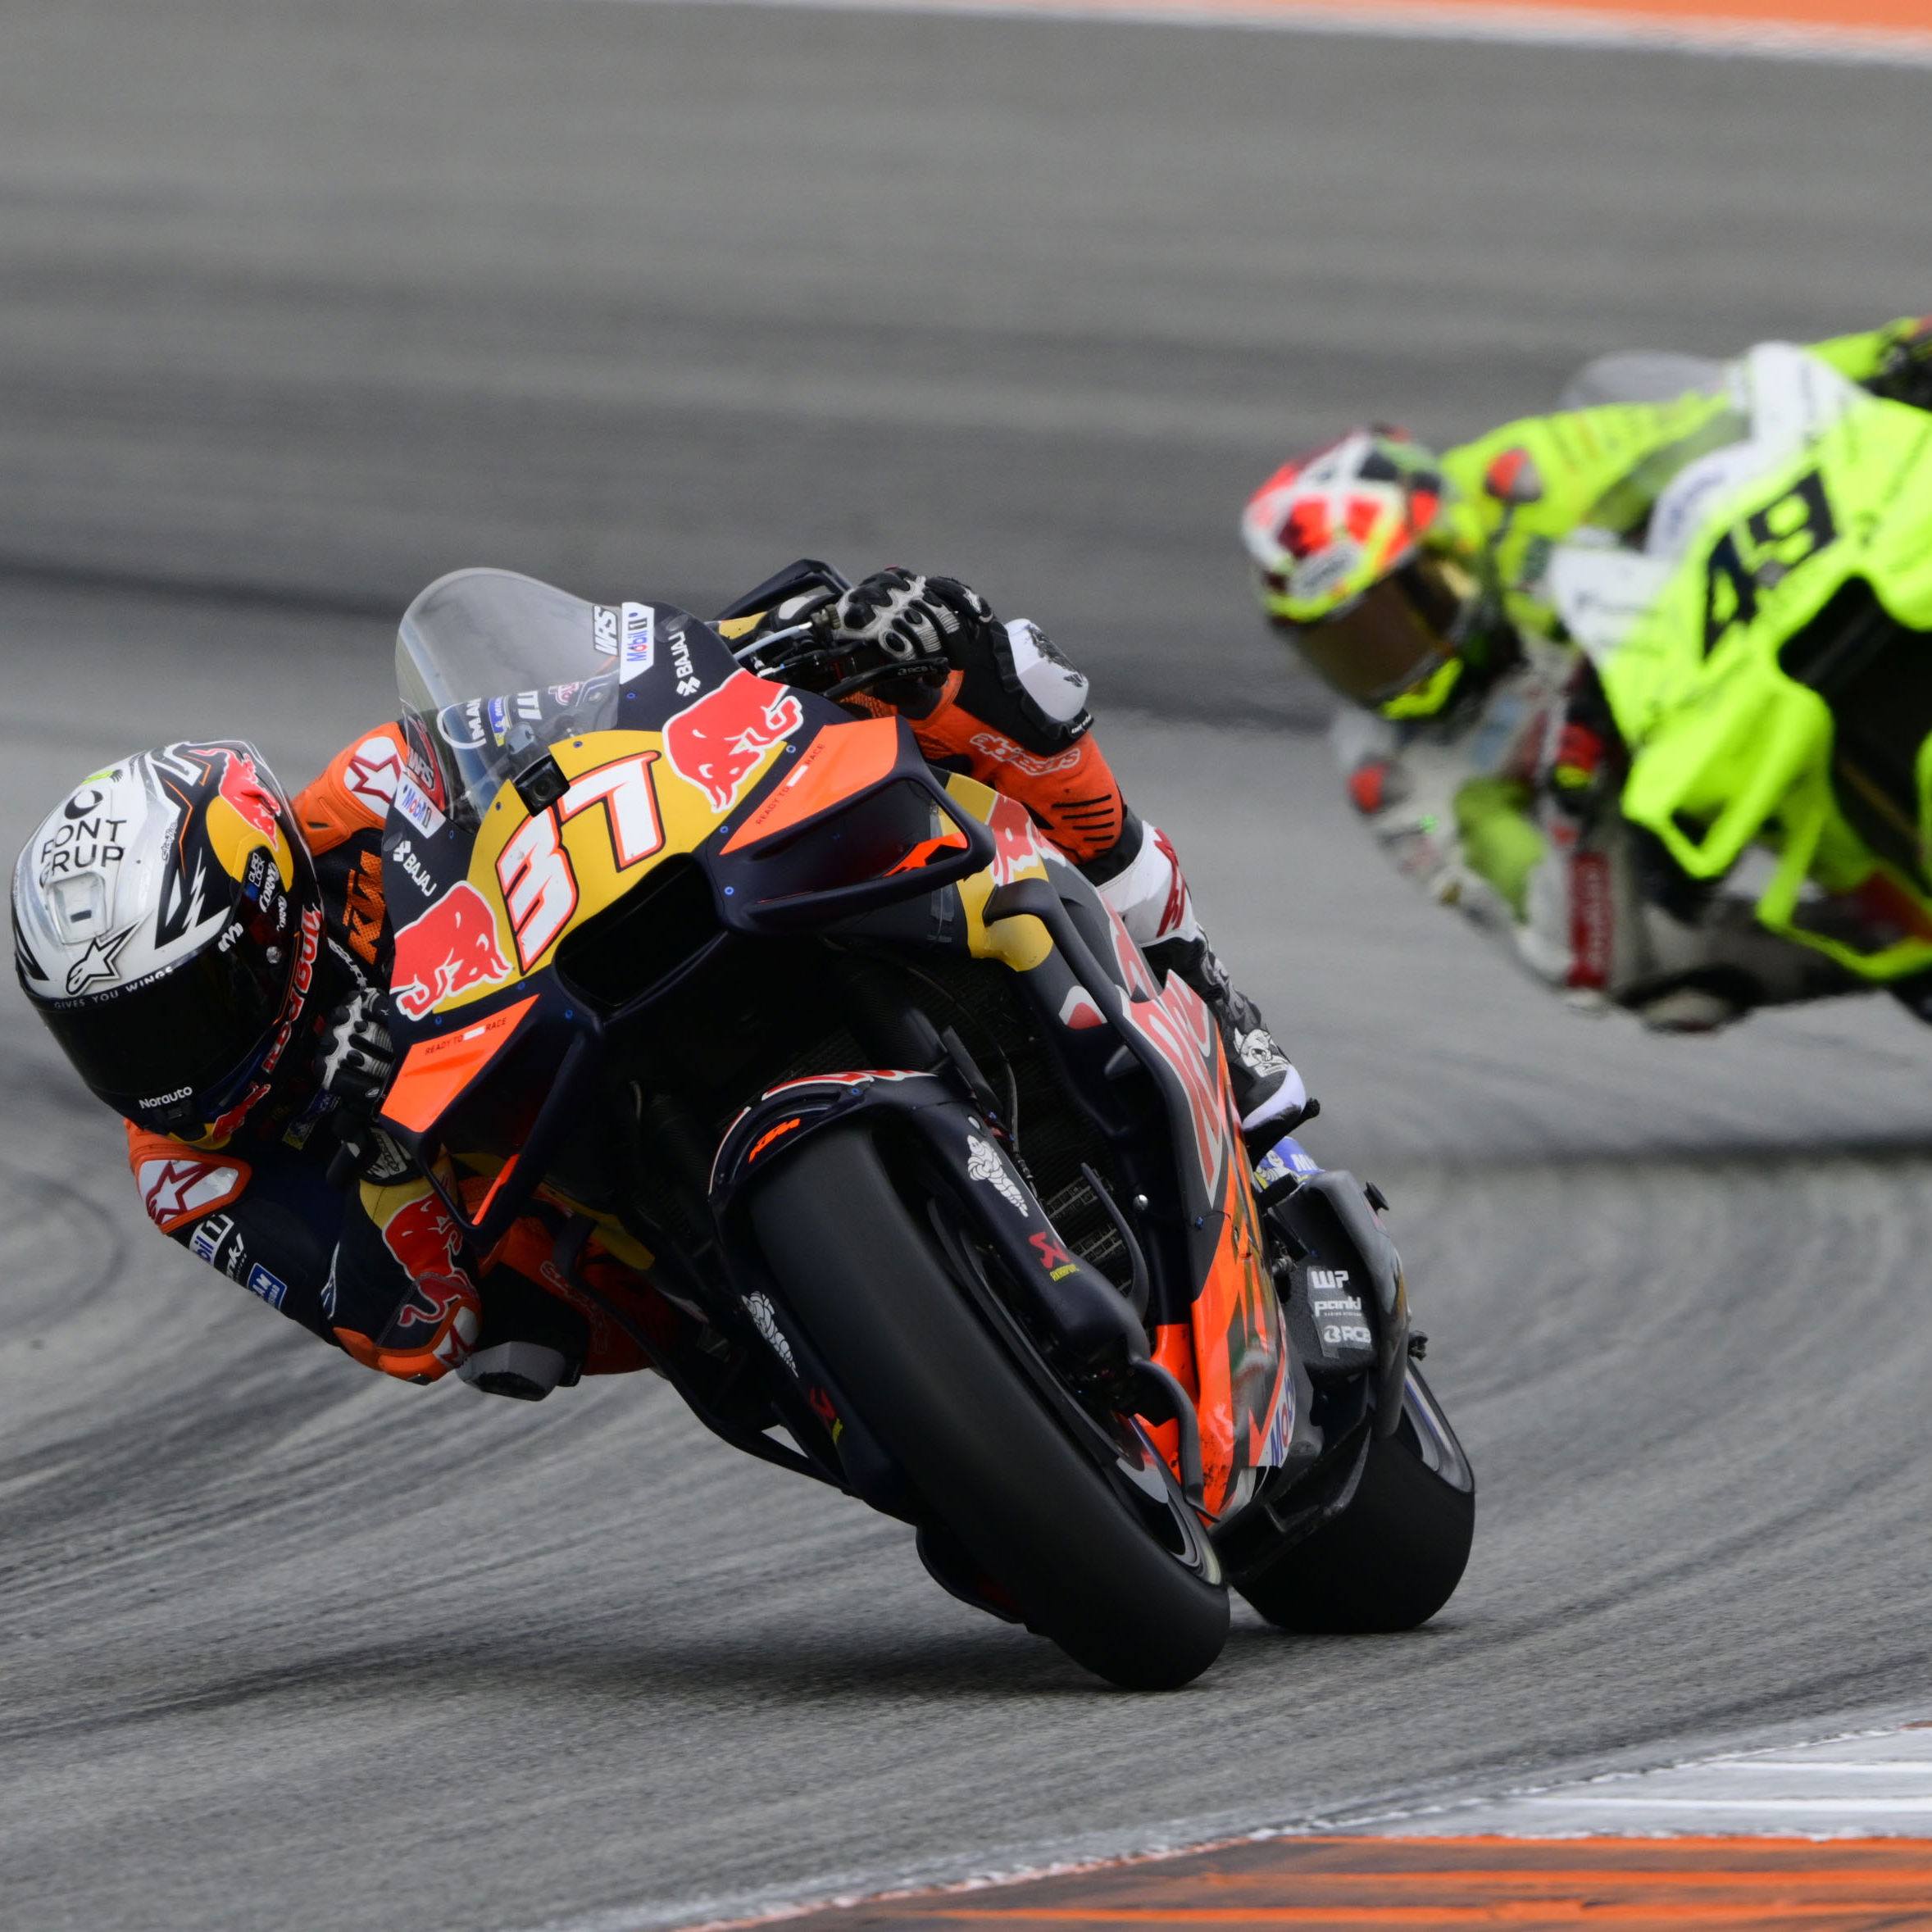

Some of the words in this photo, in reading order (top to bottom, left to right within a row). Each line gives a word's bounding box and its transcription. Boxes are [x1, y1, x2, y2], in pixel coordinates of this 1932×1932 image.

[1703, 468, 1836, 663] 49
[593, 605, 619, 657] WRS
[626, 630, 648, 661] Mobil
[668, 631, 693, 679] BAJAJ
[402, 788, 426, 823] Mobil
[755, 798, 780, 825] READY
[805, 743, 825, 764] RACE
[41, 818, 127, 864] FONT
[495, 750, 666, 975] 37
[254, 858, 265, 887] LOCK
[260, 861, 279, 912] CORNY
[403, 853, 437, 897] BAJAJ
[343, 851, 385, 965] KTM
[294, 902, 321, 993] Bull
[54, 998, 85, 1009] GIVES
[92, 990, 118, 1003] YOU
[125, 966, 173, 993] WINGS
[425, 1040, 450, 1054] READY
[485, 1017, 507, 1030] RACE
[139, 1086, 193, 1109] Norauto
[193, 1235, 214, 1262] bil
[1311, 1271, 1349, 1289] WP
[1314, 1296, 1361, 1317] pankl
